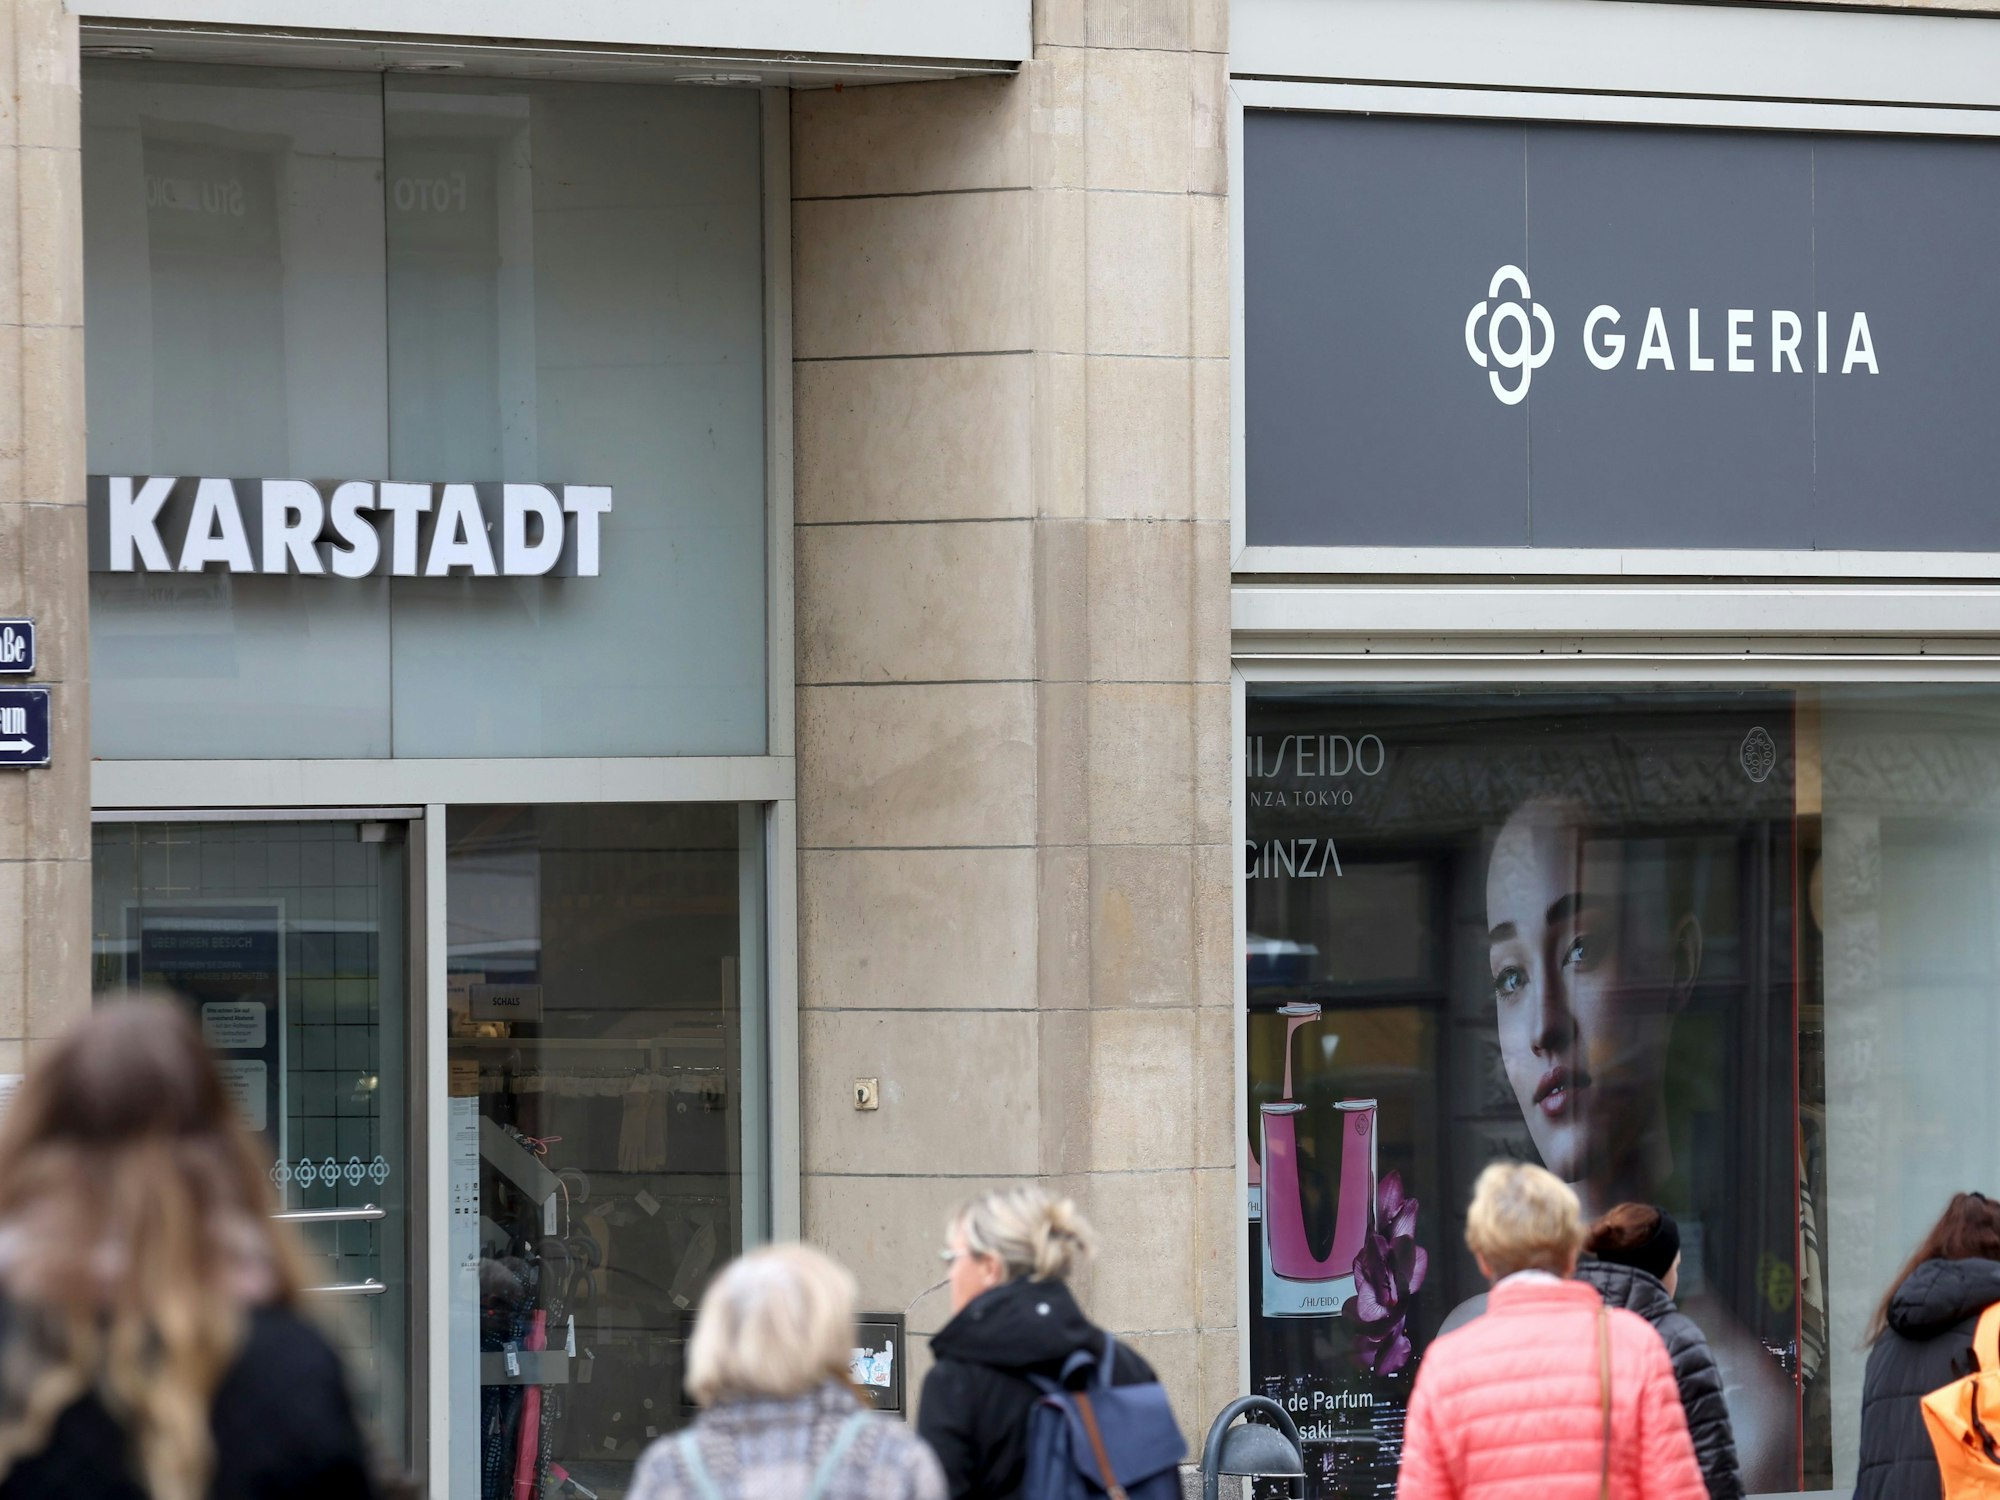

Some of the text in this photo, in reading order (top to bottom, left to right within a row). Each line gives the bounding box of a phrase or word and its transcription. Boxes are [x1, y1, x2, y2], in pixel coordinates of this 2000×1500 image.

[1583, 304, 1879, 374] GALERIA
[109, 475, 613, 578] KARSTADT
[0, 626, 26, 662] ße
[1294, 790, 1353, 806] TOKYO
[211, 936, 253, 949] BESUCH
[492, 997, 520, 1006] SCHALS
[1299, 1296, 1339, 1308] SHISEIDO
[1288, 1393, 1309, 1412] de
[1313, 1390, 1373, 1411] Parfum
[1299, 1420, 1332, 1440] saki
